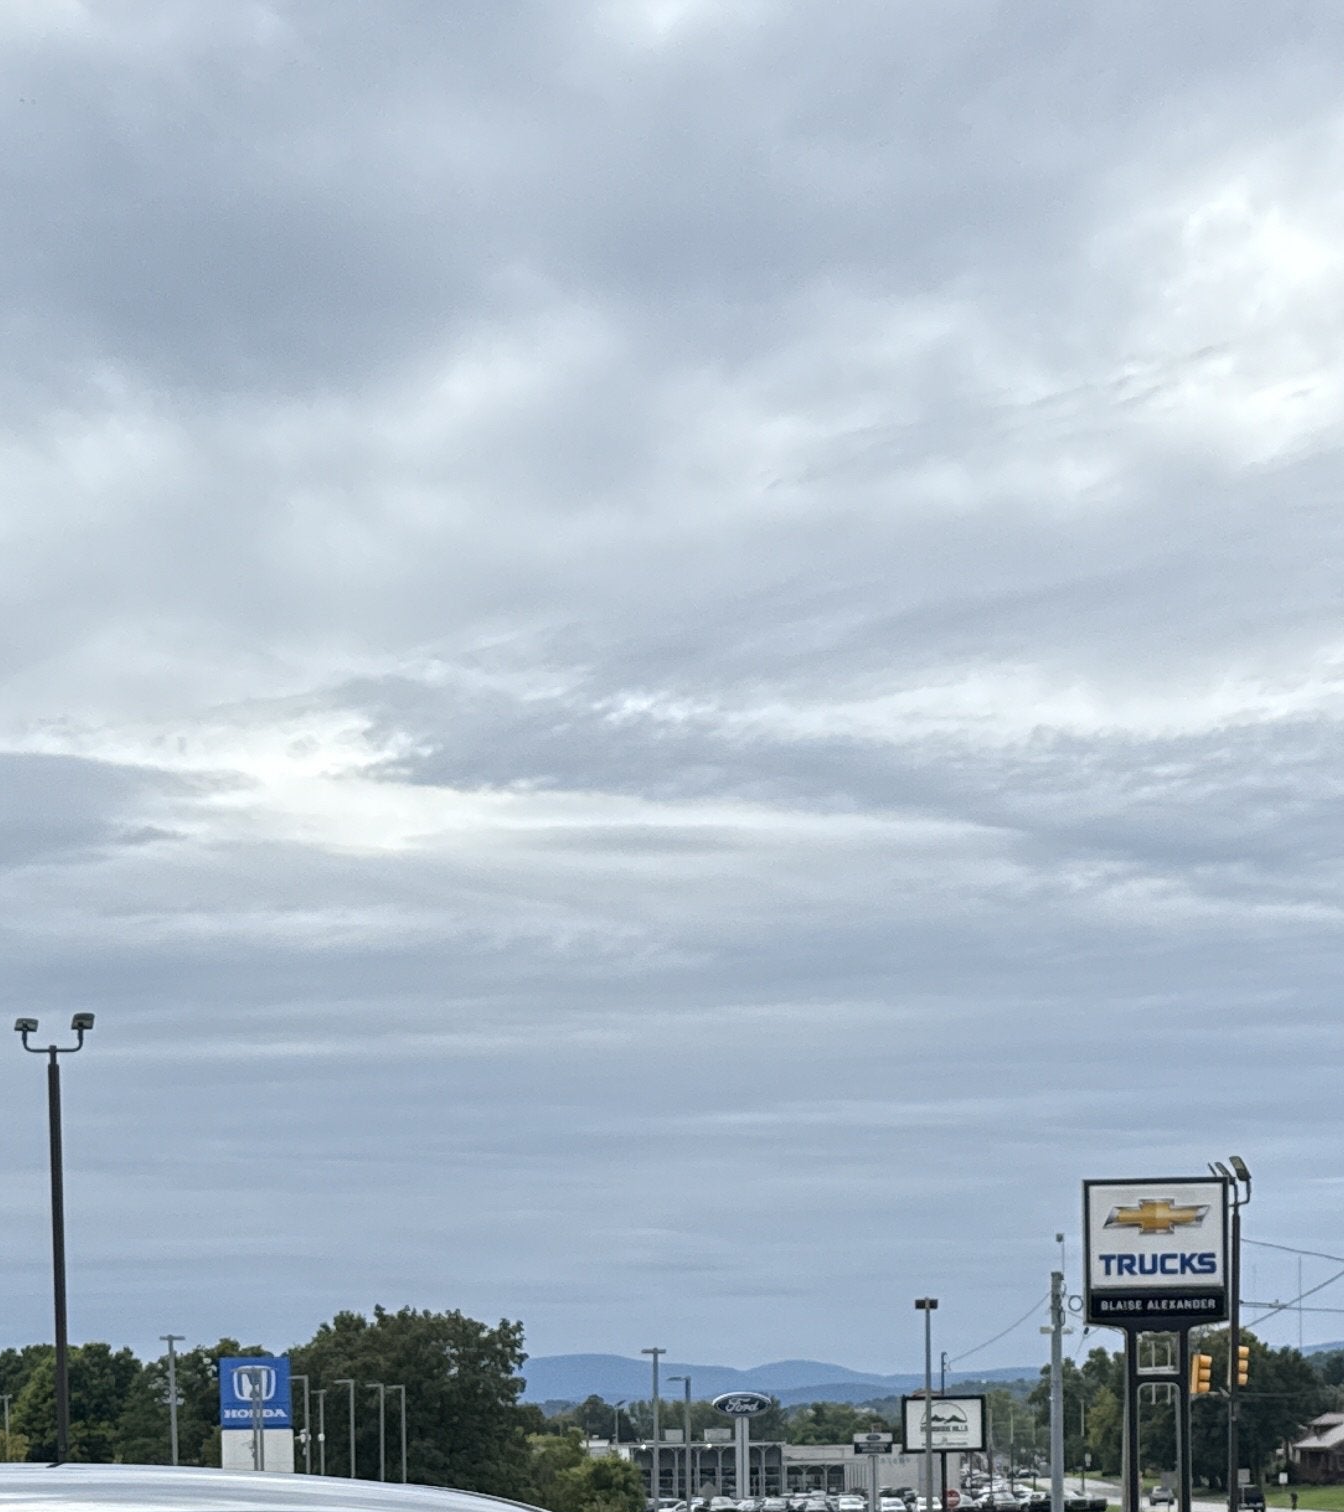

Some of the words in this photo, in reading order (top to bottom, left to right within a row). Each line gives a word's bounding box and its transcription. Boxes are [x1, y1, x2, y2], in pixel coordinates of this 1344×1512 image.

[1099, 1252, 1217, 1276] TRUCKS
[1100, 1300, 1143, 1311] BLAISE
[1146, 1298, 1216, 1310] ALEXANDER
[725, 1398, 760, 1413] Ford
